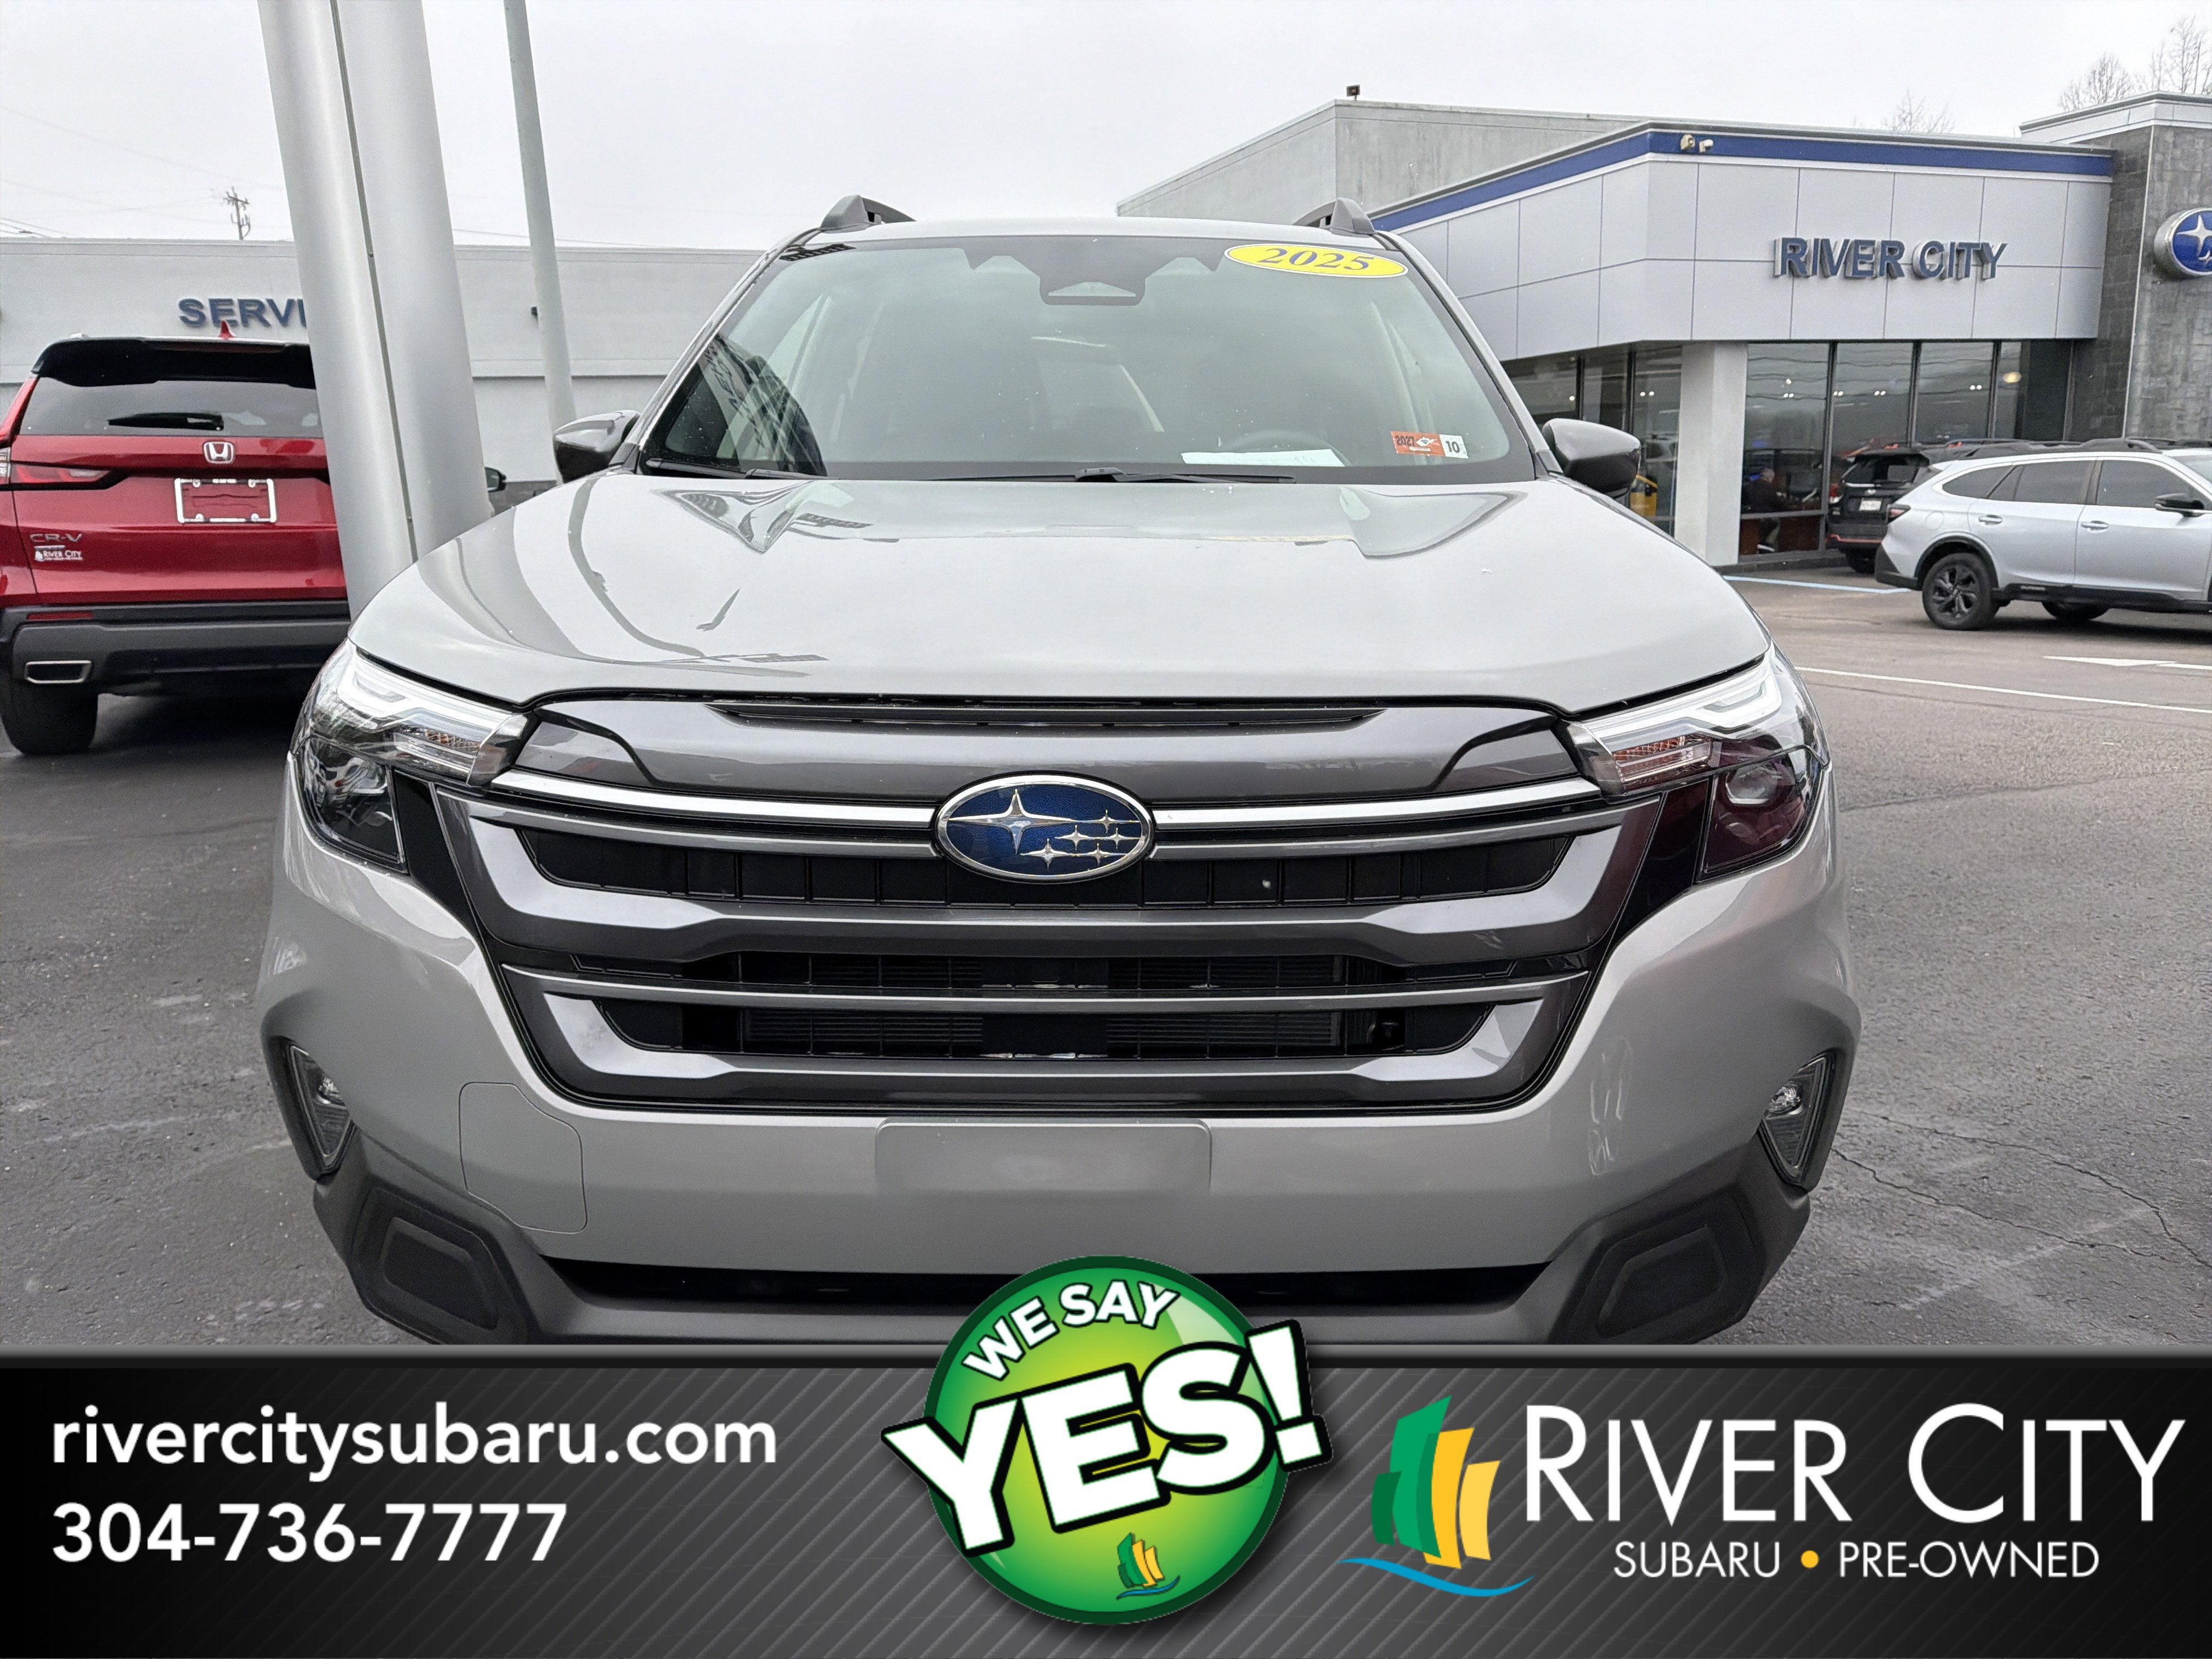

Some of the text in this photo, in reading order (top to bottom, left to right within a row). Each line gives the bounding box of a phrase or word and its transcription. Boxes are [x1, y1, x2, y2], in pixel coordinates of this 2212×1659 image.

[1257, 248, 1374, 270] 2025
[1775, 237, 2007, 280] RIVER CITY
[1445, 440, 1460, 453] 10
[30, 533, 82, 543] CR-V
